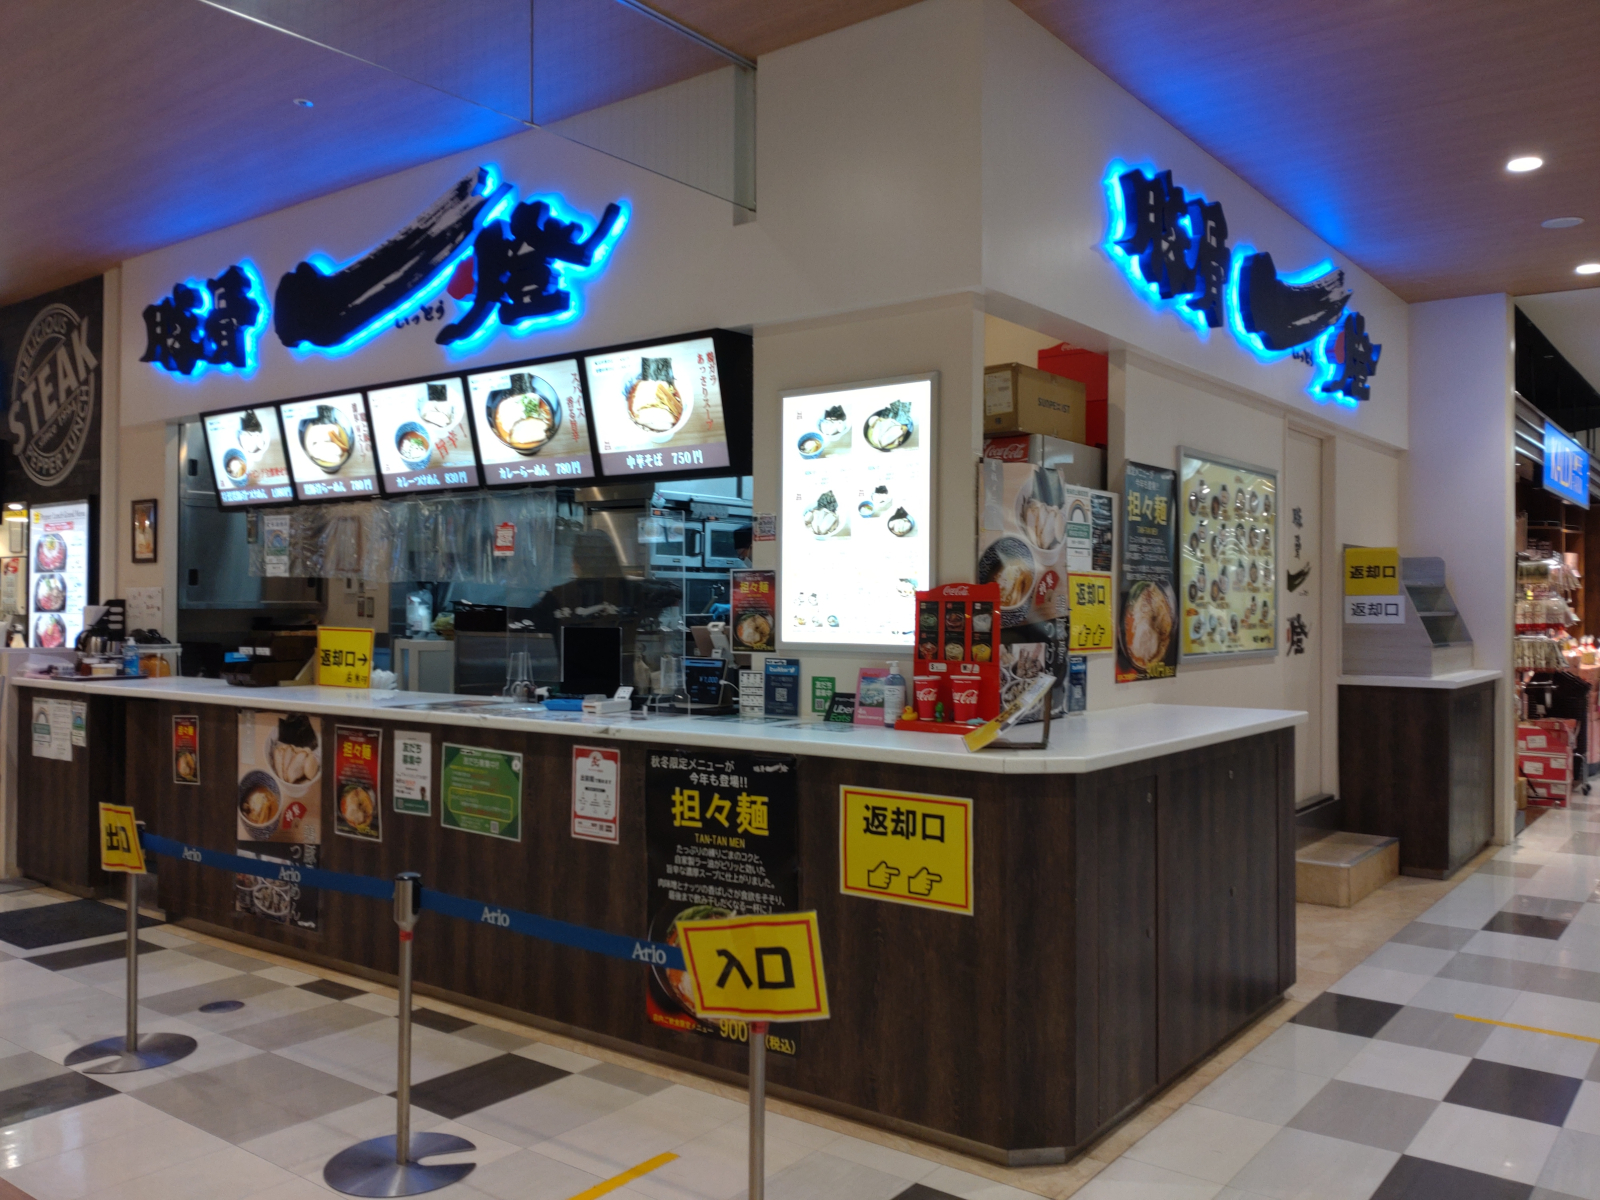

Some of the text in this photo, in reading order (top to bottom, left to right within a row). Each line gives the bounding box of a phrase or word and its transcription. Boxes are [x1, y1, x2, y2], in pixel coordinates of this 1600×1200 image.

[8, 315, 99, 455] STEAK
[26, 385, 90, 475] PEPPER LUNCH
[626, 449, 703, 470] 中華そば 750円
[396, 475, 441, 488] カレーつけめん
[499, 465, 549, 480] カレーらーめん
[1127, 489, 1168, 526] 担々麺
[1350, 564, 1396, 580] 返却口
[740, 581, 769, 594] 担々麺
[942, 585, 970, 596] Coca-Cola
[1076, 583, 1106, 606] 返却口
[1351, 602, 1399, 617] 返却口
[320, 649, 355, 667] 返却口
[830, 713, 851, 723] Eats
[833, 704, 855, 714] Uber
[343, 741, 372, 760] 担々麺
[650, 755, 735, 773] 秋冬限定メニューが
[671, 786, 769, 836] 担々麺
[862, 804, 945, 843] 返却口
[106, 823, 132, 854] 出口
[694, 832, 746, 849] TAN-TAN MEN
[182, 847, 202, 862] Ario
[278, 867, 301, 882] Ario
[480, 906, 510, 928] Ario
[632, 941, 666, 965] Ario
[715, 946, 795, 990] 入口
